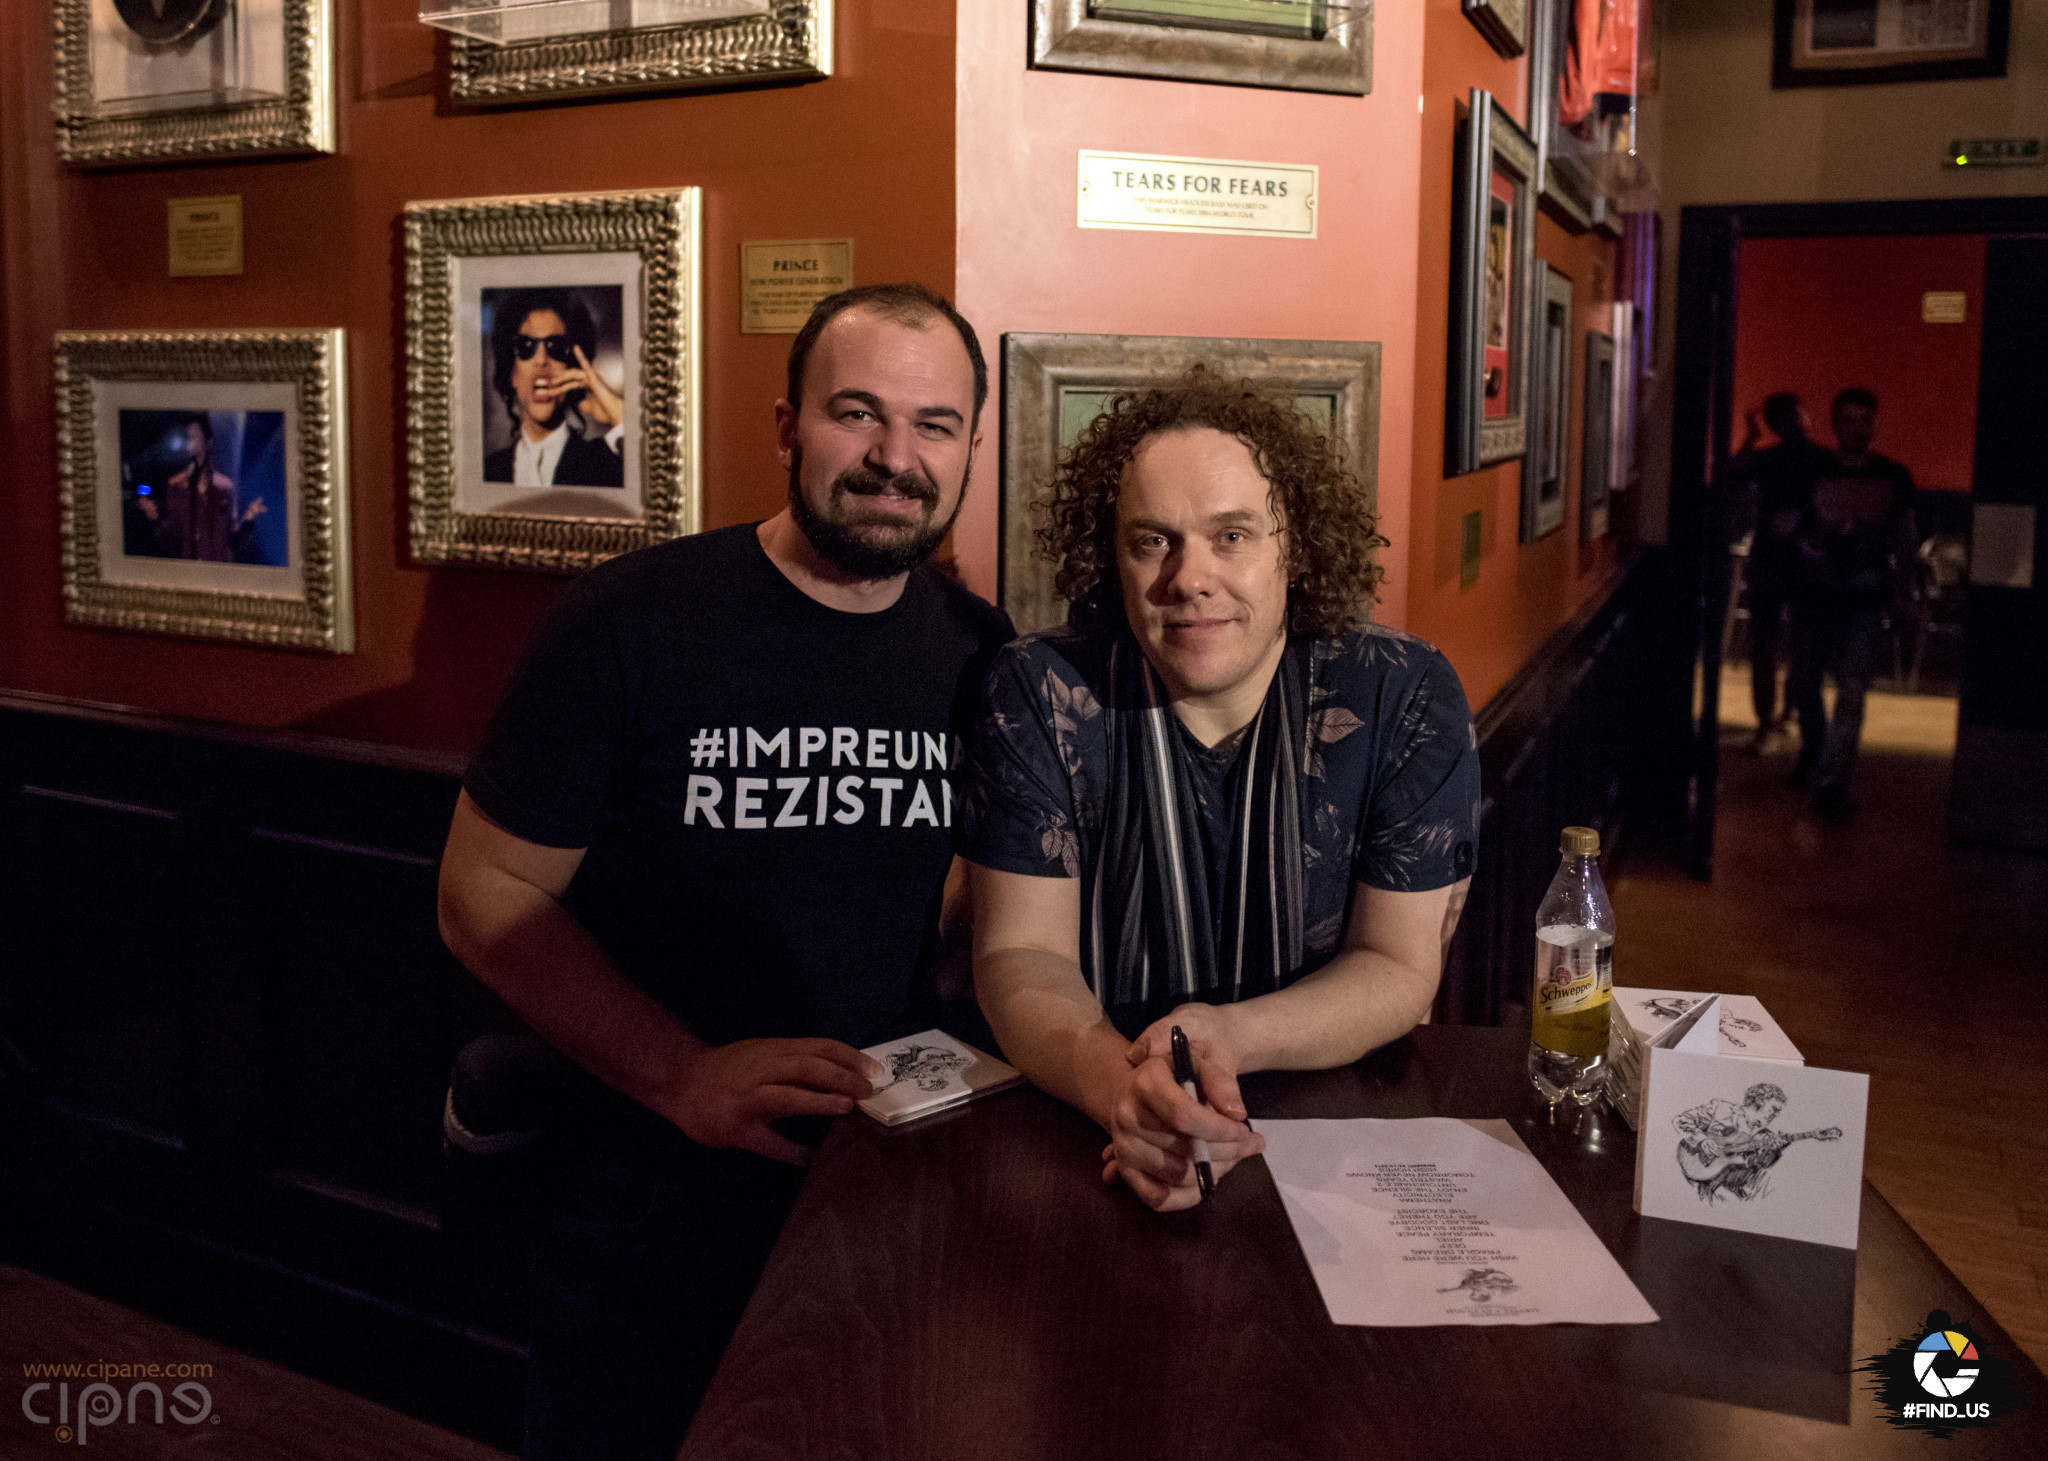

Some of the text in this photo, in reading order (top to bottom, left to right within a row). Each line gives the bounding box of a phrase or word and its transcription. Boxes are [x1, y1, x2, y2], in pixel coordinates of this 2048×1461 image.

[1112, 171, 1289, 198] TEARS FOR FEARS
[773, 259, 819, 271] PRINCE
